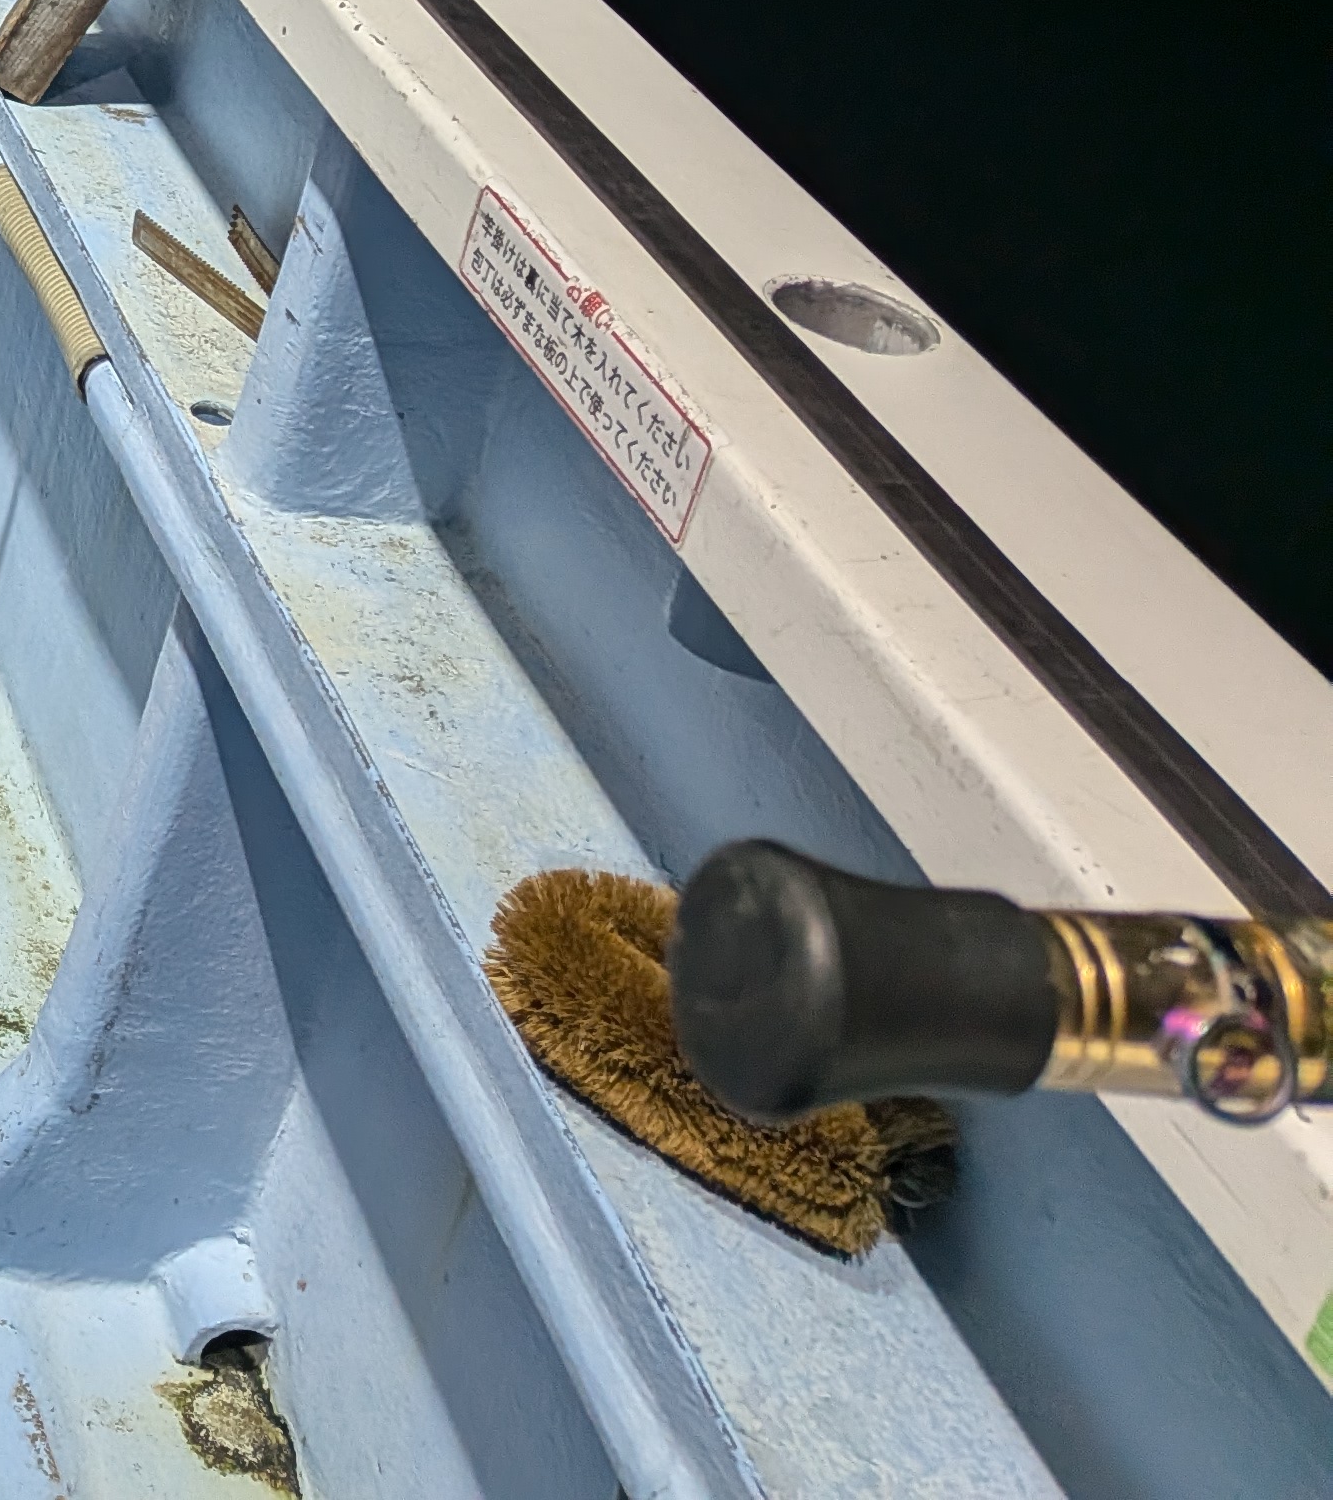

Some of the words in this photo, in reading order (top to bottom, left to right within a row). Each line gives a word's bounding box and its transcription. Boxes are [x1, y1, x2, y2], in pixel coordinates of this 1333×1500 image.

[471, 248, 677, 508] 包丁は必ずまな板の上で使ってください
[566, 285, 614, 330] お願い
